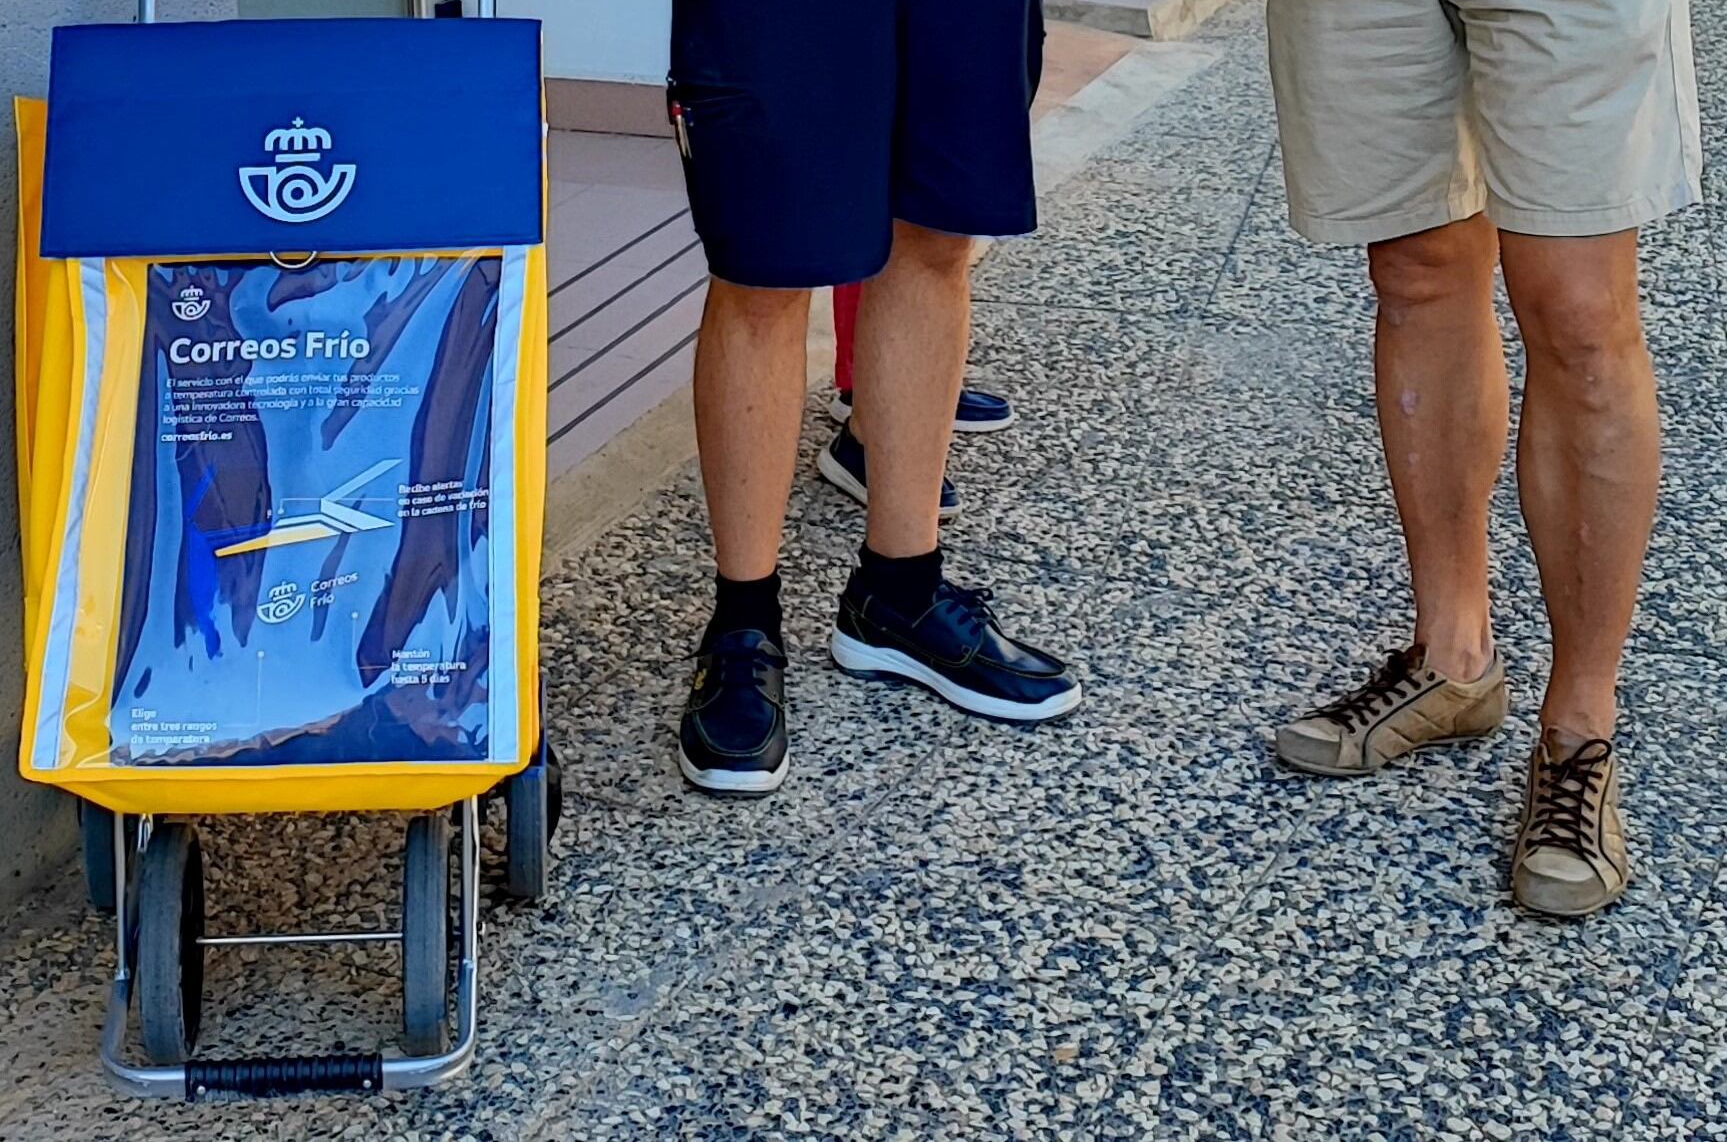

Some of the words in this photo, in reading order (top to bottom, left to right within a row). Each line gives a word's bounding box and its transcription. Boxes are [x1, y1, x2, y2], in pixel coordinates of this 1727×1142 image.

[169, 337, 296, 364] Correos
[306, 330, 370, 358] Frío
[166, 378, 176, 388] El
[177, 377, 214, 387] servicio
[215, 378, 232, 386] con
[234, 375, 244, 385] el
[245, 376, 264, 386] que
[266, 373, 299, 385] podrás
[301, 373, 331, 383] enviar
[333, 374, 347, 383] tus
[349, 373, 399, 384] productos
[164, 392, 171, 400] a
[173, 389, 233, 401] temperatura
[235, 387, 286, 398] controlada
[289, 386, 306, 395] con
[309, 385, 331, 395] total
[333, 385, 382, 397] seguridad
[384, 386, 419, 397] gracias
[163, 404, 170, 412] a
[172, 403, 190, 411] una
[301, 399, 307, 409] y
[308, 399, 314, 407] a
[316, 398, 325, 406] la
[326, 399, 349, 409] gran
[351, 398, 401, 409] capacidad
[205, 414, 217, 423] de
[219, 413, 258, 423] Correos.
[398, 483, 431, 494] Recibe
[432, 480, 463, 491] alertas
[412, 496, 433, 505] caso
[434, 493, 446, 502] de
[411, 507, 420, 516] la
[422, 504, 454, 515] cadena
[455, 502, 467, 511] de
[310, 572, 359, 593] Correos
[310, 593, 334, 609] Frío
[391, 661, 400, 671] la
[402, 661, 467, 672] temperatura
[391, 674, 420, 684] hasta
[421, 674, 428, 683] 5
[131, 708, 157, 720] Elige
[131, 722, 159, 731] entre
[160, 722, 181, 731] tres
[182, 722, 217, 732] rangos
[130, 735, 144, 744] de
[145, 735, 210, 745] temperatura
